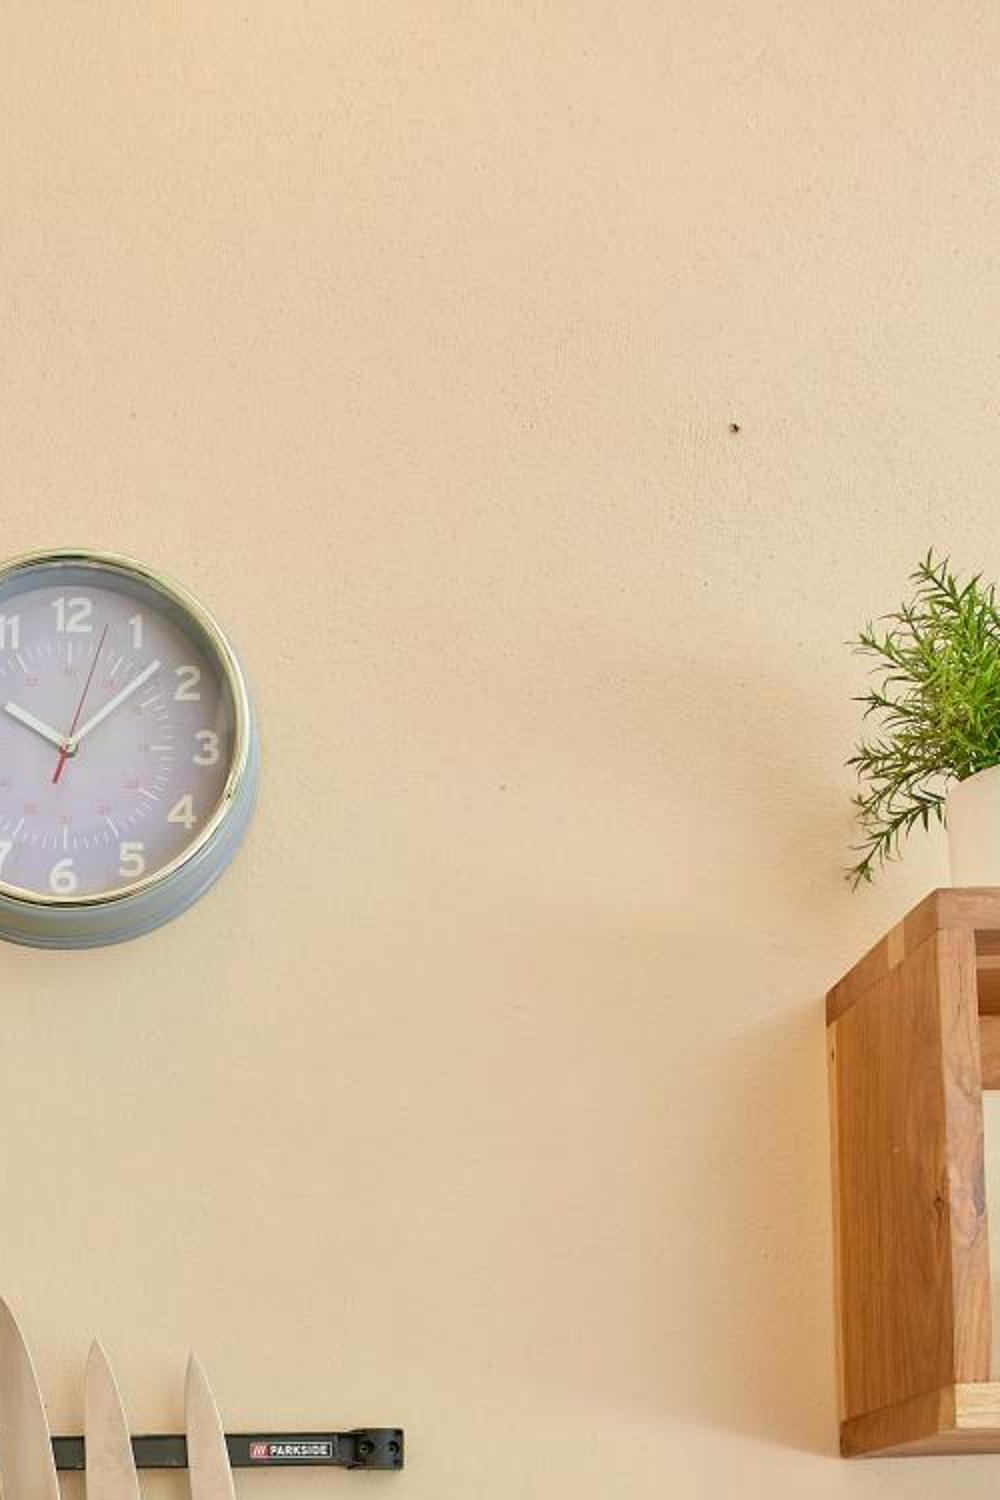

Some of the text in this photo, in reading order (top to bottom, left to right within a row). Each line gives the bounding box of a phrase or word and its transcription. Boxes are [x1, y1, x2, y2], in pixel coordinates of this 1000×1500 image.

[51, 598, 93, 633] 12
[128, 614, 143, 649] 1
[174, 665, 201, 701] 2
[192, 730, 220, 766] 3
[167, 794, 198, 829] 4
[49, 858, 78, 893] 6
[119, 843, 145, 877] 5
[269, 1445, 328, 1456] PARKSIDE
